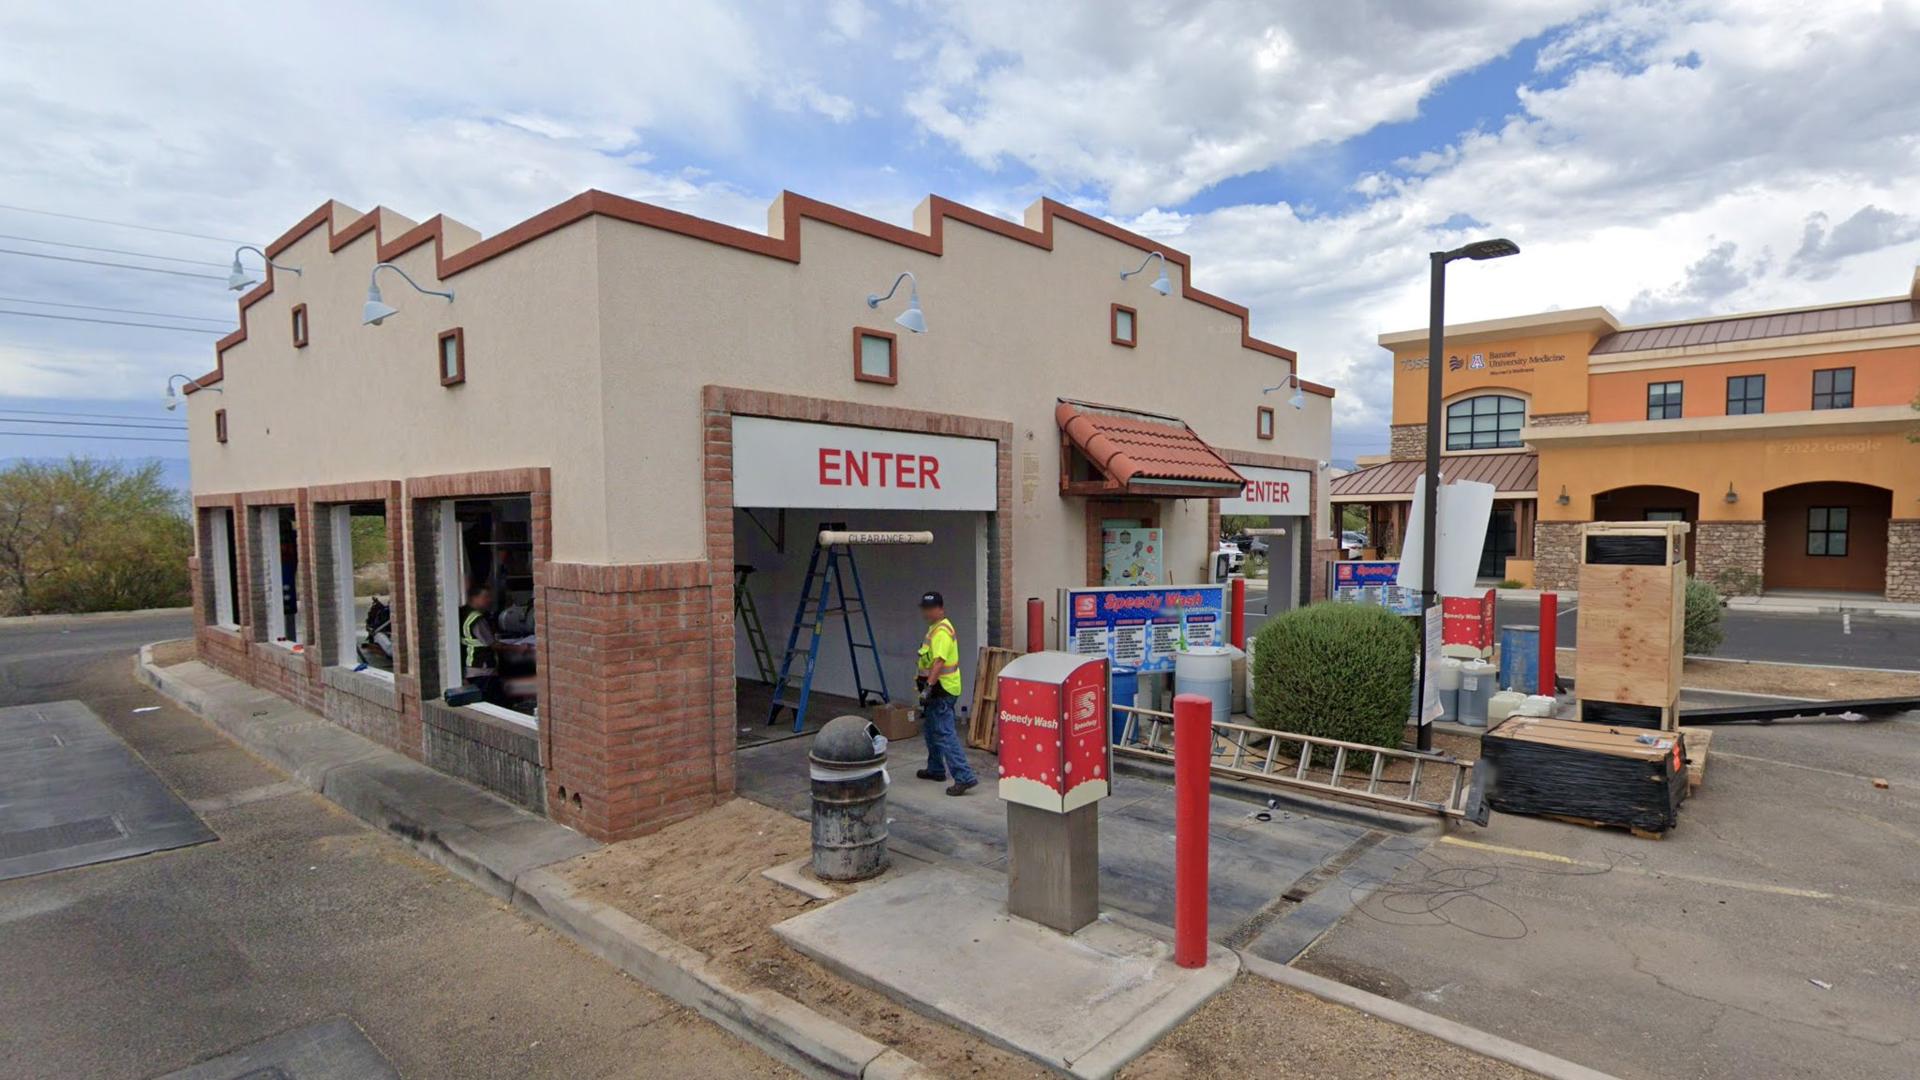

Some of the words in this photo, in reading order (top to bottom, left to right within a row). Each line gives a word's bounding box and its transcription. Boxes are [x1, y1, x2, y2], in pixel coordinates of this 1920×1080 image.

[1489, 351, 1516, 360] Banner
[1489, 357, 1528, 368] University
[1529, 353, 1566, 364] Medicine
[819, 448, 941, 489] ENTER
[1246, 480, 1290, 503] ENTER
[848, 534, 905, 544] CLEARANCE
[1105, 593, 1162, 612] Speedy
[1165, 591, 1203, 608] Wash
[1000, 710, 1033, 727] Speedy
[1034, 715, 1059, 730] Wash
